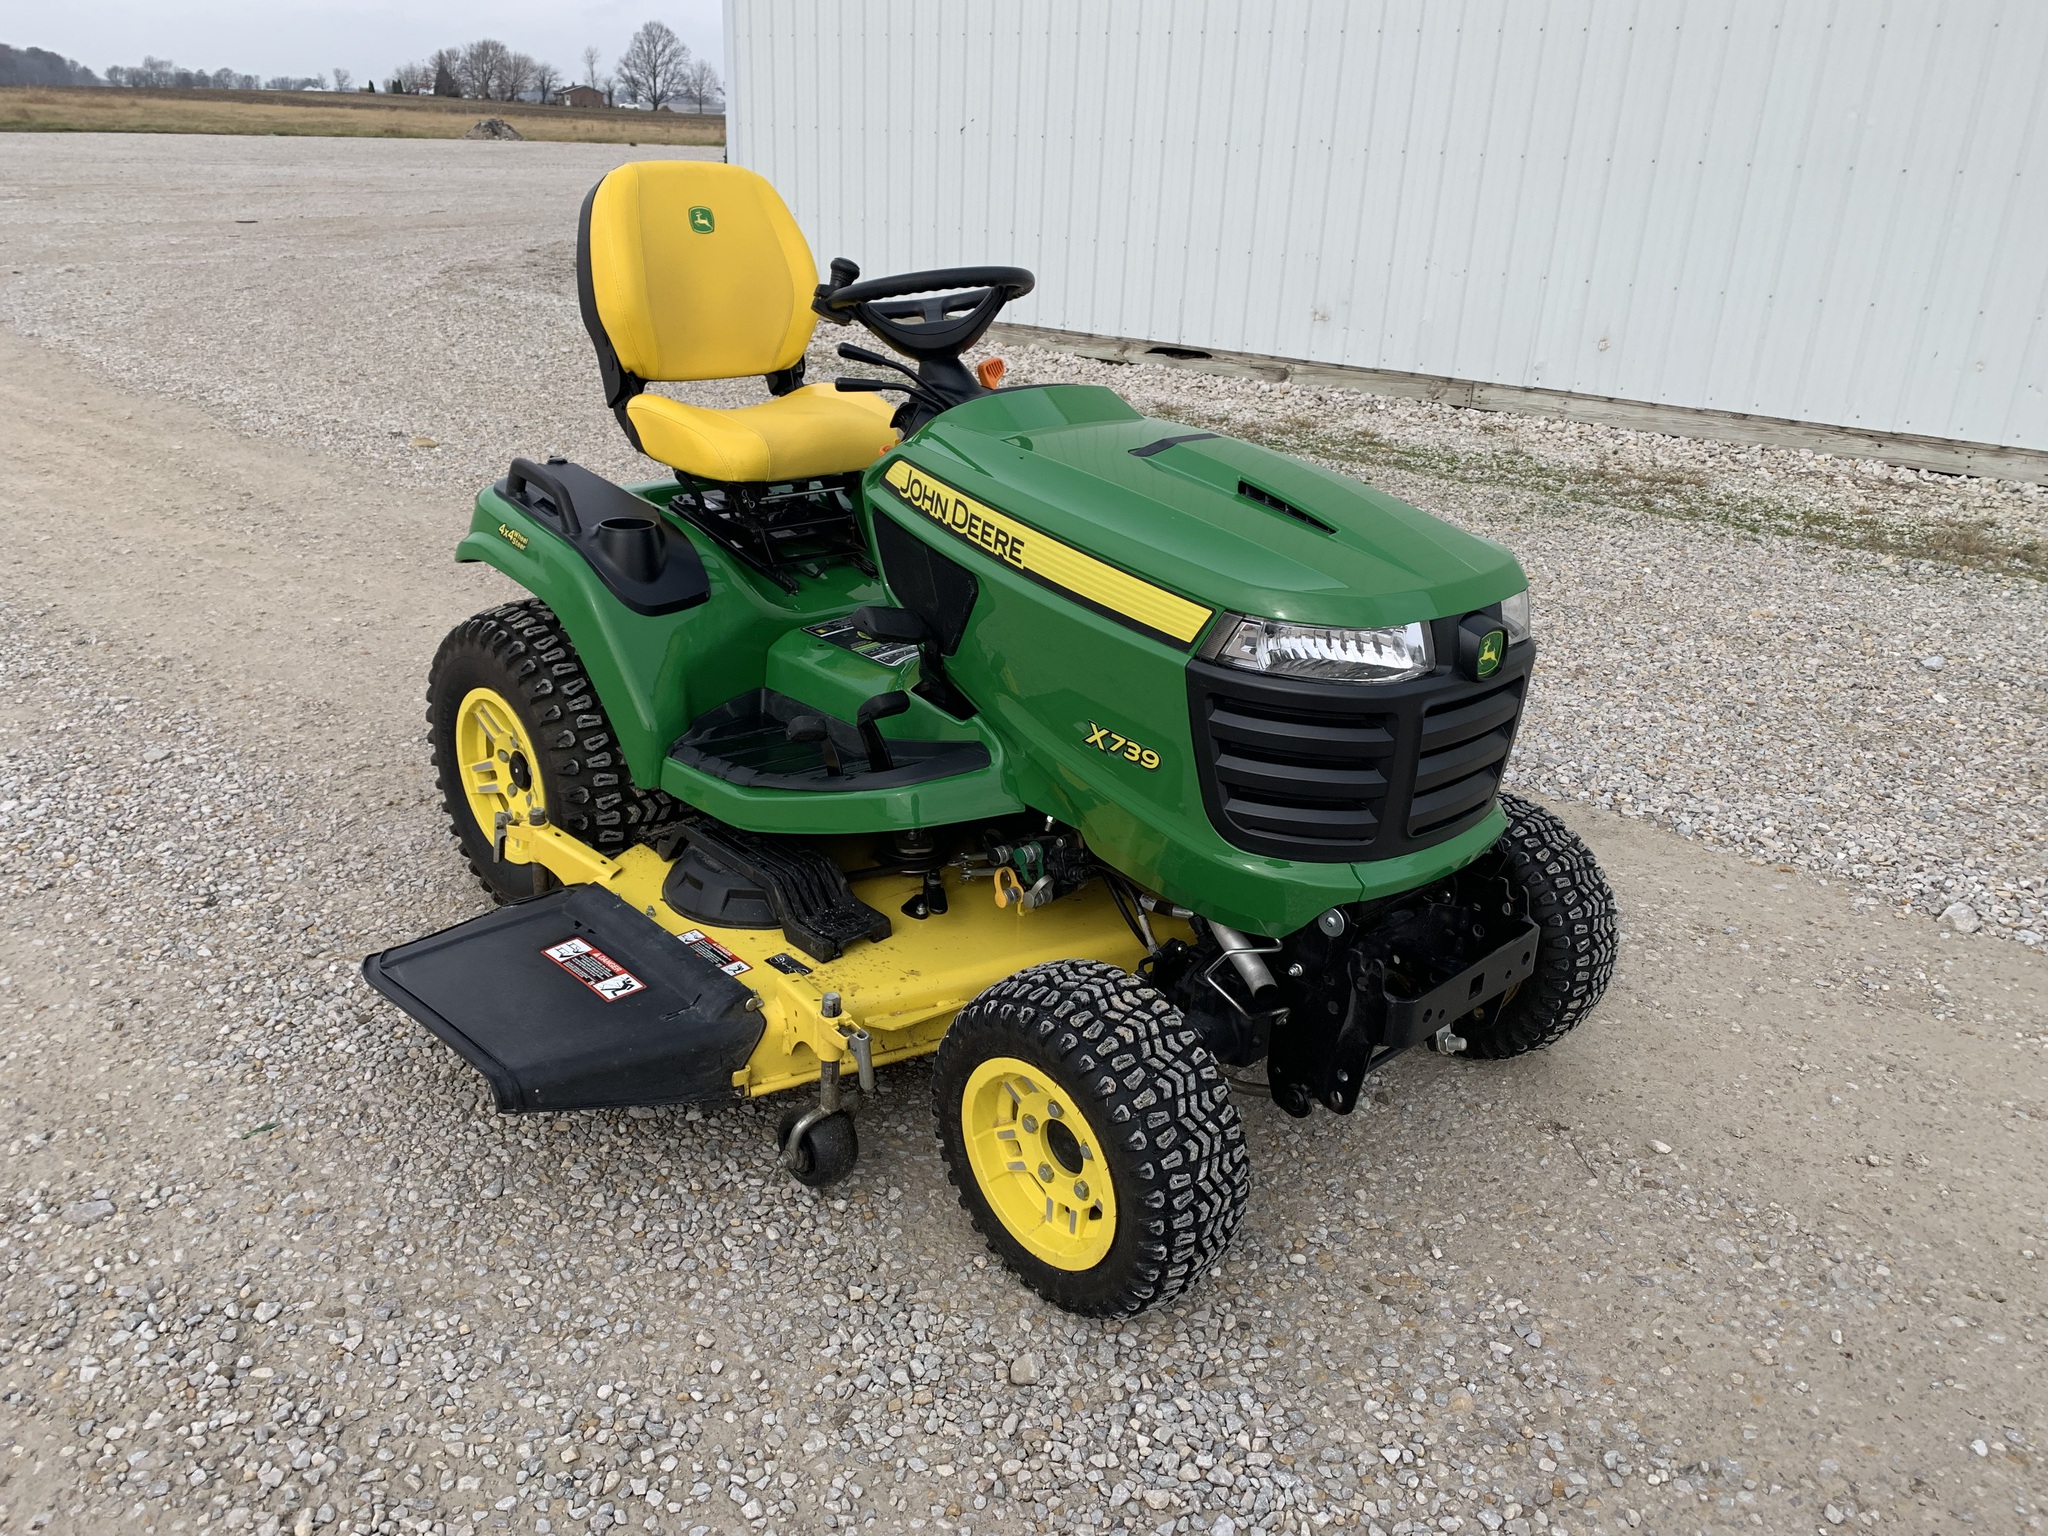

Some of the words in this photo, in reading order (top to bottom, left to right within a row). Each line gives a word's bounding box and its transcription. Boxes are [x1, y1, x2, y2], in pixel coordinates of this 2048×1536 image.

[498, 523, 515, 541] 4x4
[899, 469, 949, 520] JOHN
[951, 498, 1025, 565] DEERE
[1083, 721, 1162, 770] X739
[599, 955, 623, 972] DANGER
